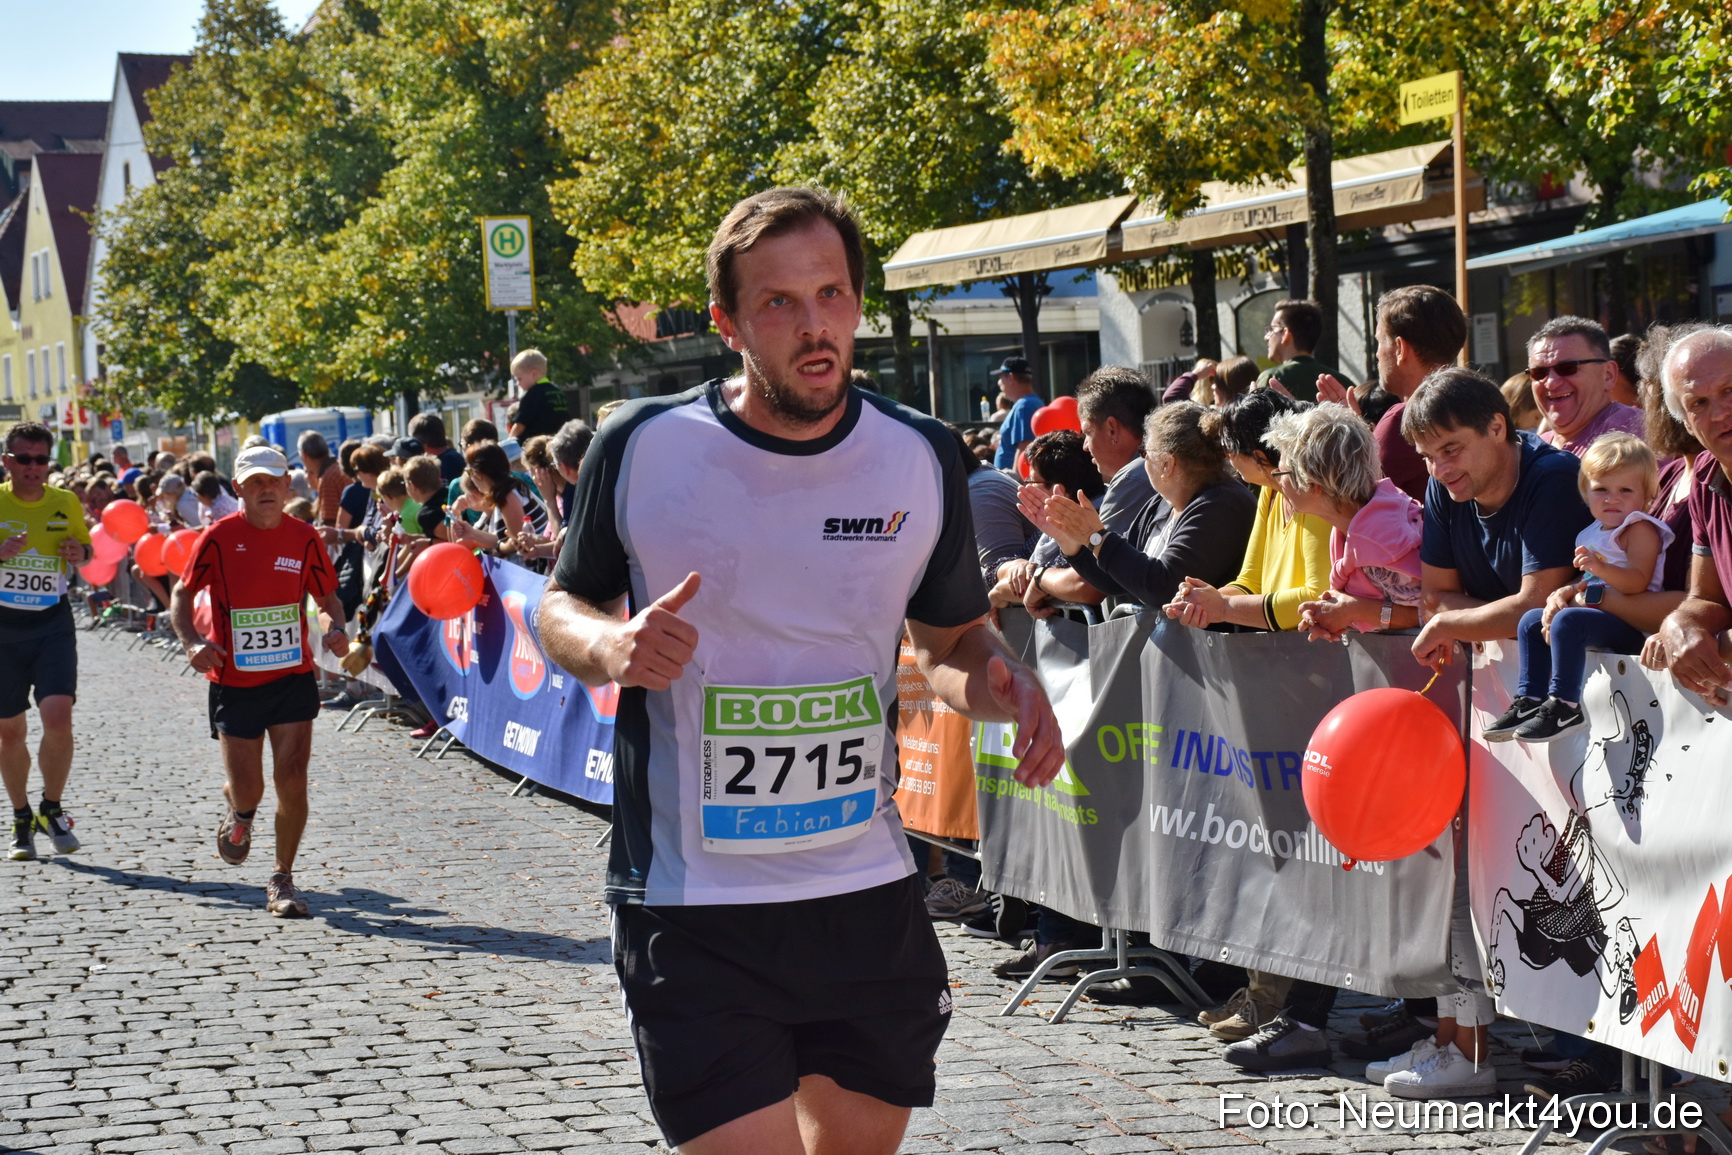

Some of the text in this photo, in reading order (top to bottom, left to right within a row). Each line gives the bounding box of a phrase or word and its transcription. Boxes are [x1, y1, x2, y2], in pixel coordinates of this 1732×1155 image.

[1411, 88, 1454, 110] Toiletten
[499, 230, 516, 250] H
[823, 517, 884, 534] swn
[822, 533, 897, 543] stadtwerke neumarkt
[4, 555, 56, 572] BOCK
[274, 556, 302, 570] JURA
[4, 572, 53, 592] 2306
[13, 594, 42, 604] CLIFF
[236, 606, 296, 627] BOCK
[241, 626, 294, 651] 2331
[245, 650, 294, 665] HERBERT
[715, 684, 873, 731] BOCK
[724, 736, 865, 796] 2715
[1170, 729, 1303, 791] INDUSTR
[1306, 764, 1331, 778] energie
[735, 807, 832, 836] Fabian
